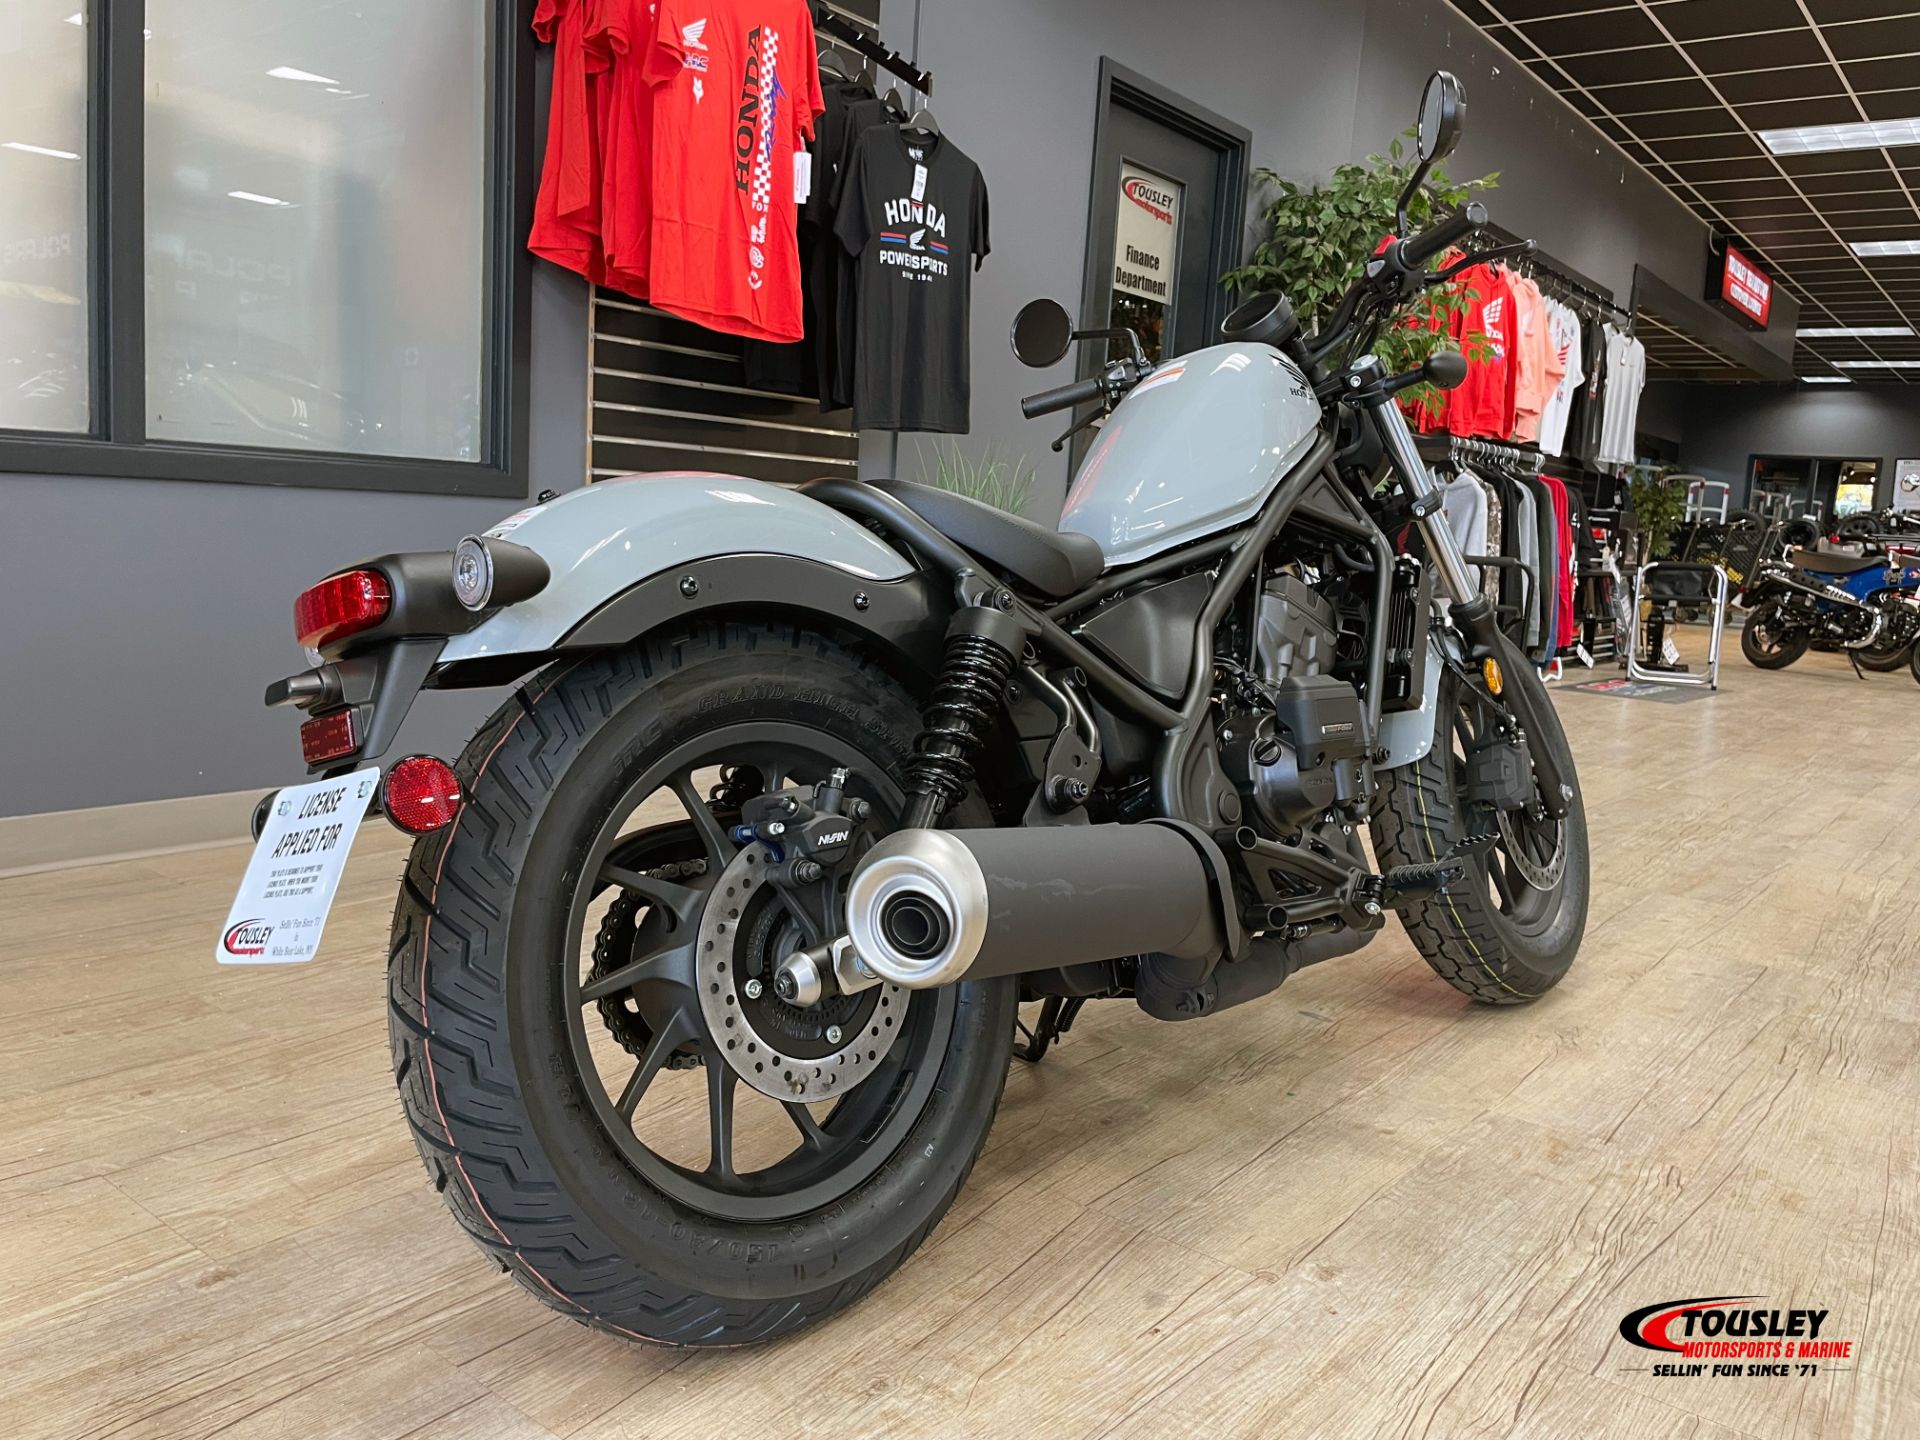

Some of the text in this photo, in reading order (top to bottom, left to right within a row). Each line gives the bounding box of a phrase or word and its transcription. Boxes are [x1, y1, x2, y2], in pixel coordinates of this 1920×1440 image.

[735, 24, 762, 196] HONDA
[1132, 184, 1174, 209] TOUSLEY
[884, 198, 946, 238] HONDA
[1126, 244, 1160, 271] Finance
[1115, 266, 1166, 297] Department
[698, 685, 785, 713] GRAND
[298, 787, 348, 819] LICENSE
[271, 823, 343, 859] APPLIED FOR
[236, 926, 275, 946] TOUSLEY
